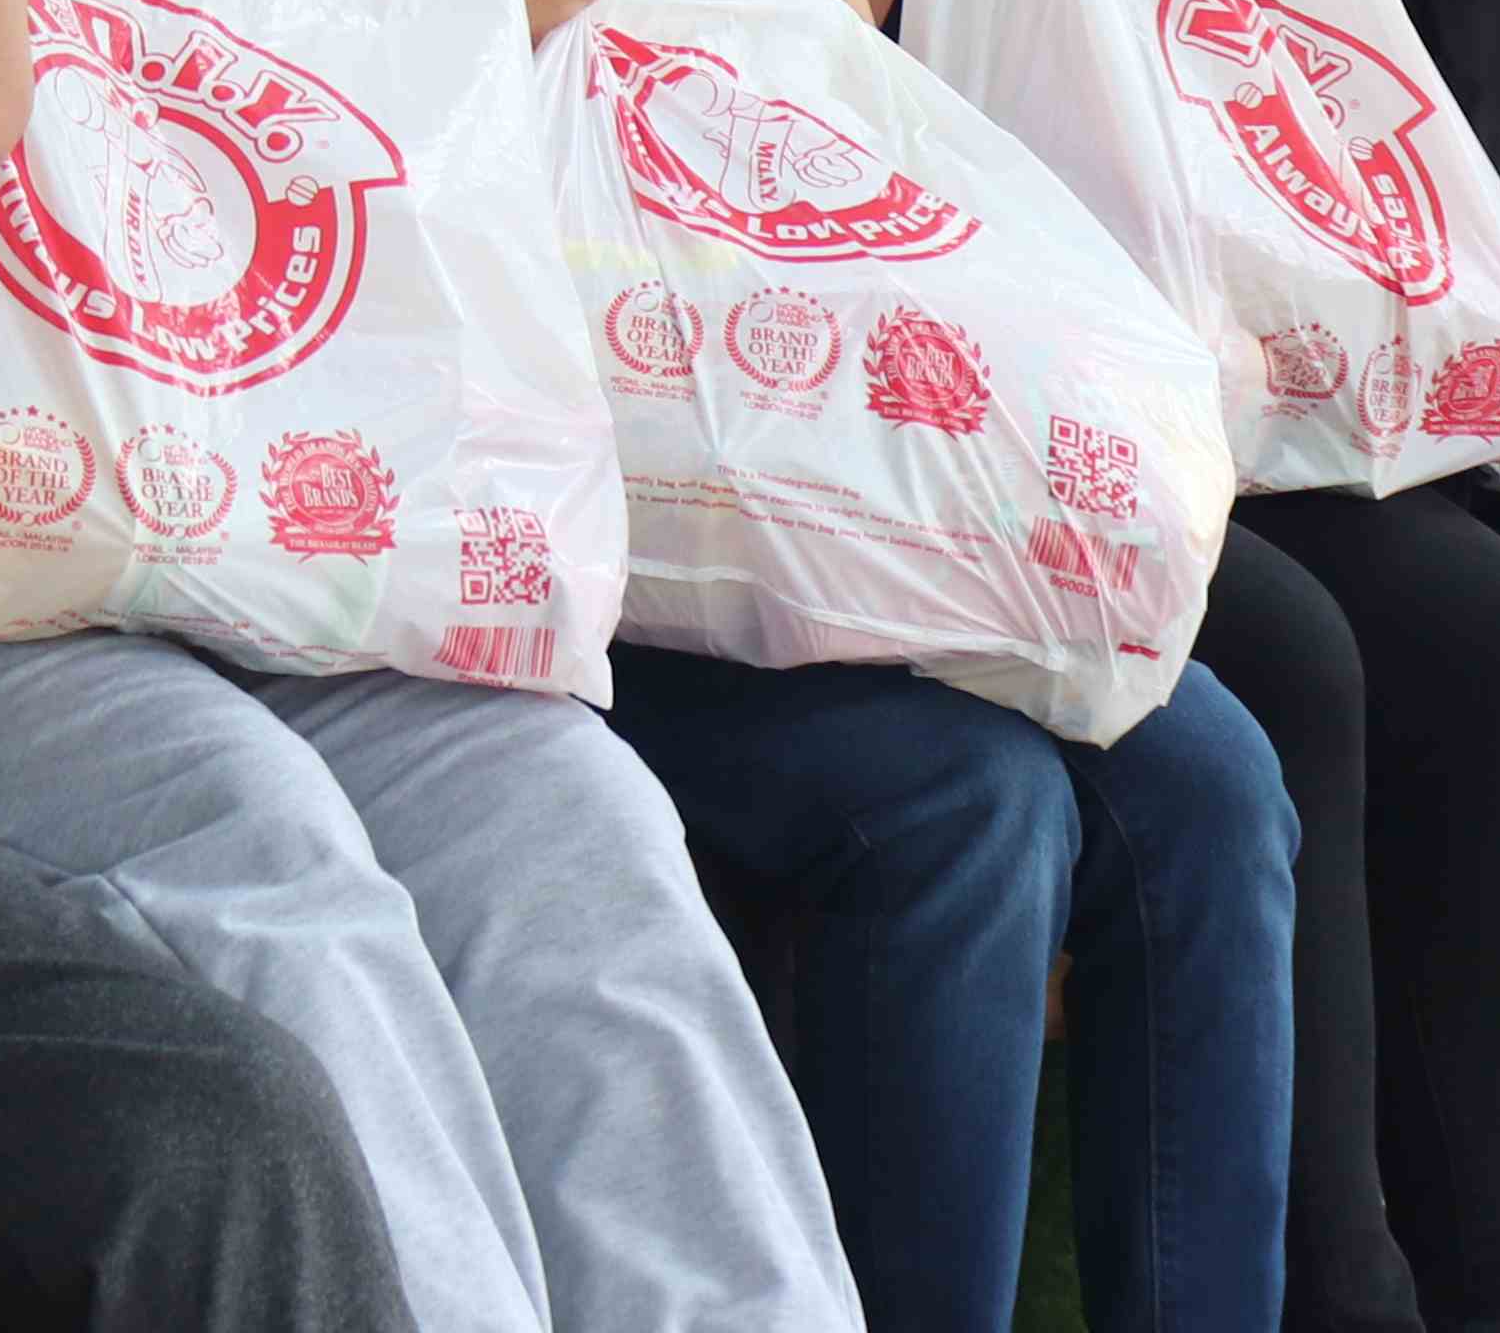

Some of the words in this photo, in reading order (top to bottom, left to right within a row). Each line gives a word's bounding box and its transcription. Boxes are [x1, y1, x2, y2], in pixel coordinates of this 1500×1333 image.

[849, 189, 947, 241] Price
[217, 225, 322, 356] Prices
[627, 330, 652, 343] OF
[750, 327, 818, 347] BRAND
[748, 342, 776, 356] OF
[780, 345, 817, 363] THE
[760, 356, 808, 376] YEAR
[27, 470, 72, 490] THE
[320, 463, 354, 487] BEST
[3, 486, 57, 506] YEAR
[141, 484, 169, 500] OF
[172, 485, 214, 502] THE
[302, 481, 360, 508] BRANDS
[153, 500, 203, 518] YEAR
